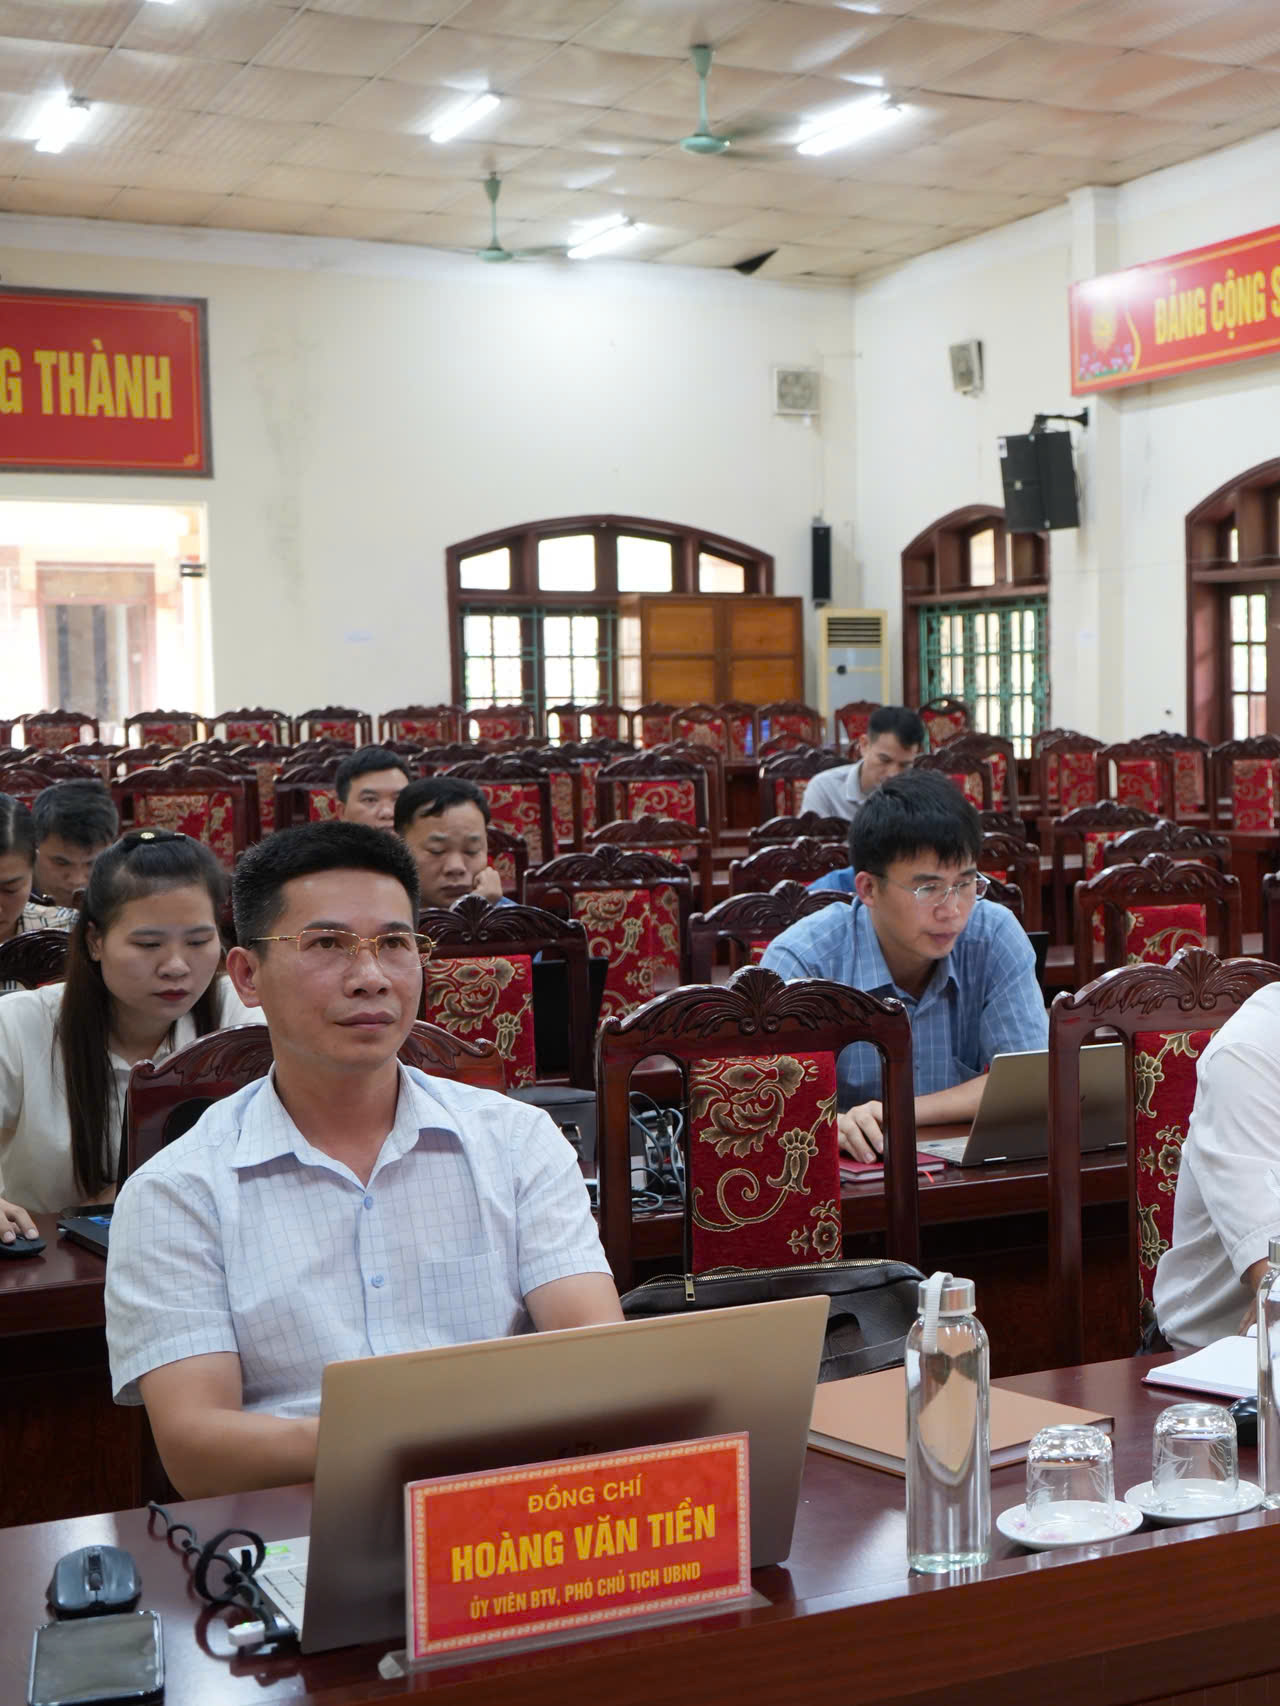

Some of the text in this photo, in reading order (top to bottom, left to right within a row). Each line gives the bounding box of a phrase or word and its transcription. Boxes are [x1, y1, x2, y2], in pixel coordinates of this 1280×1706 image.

[1211, 269, 1266, 339] CỘNG
[34, 338, 173, 420] THÀNH
[528, 1473, 642, 1513] ĐỒNG CHÍ
[451, 1496, 716, 1583] HOÀNG VĂN TIỀN
[469, 1595, 490, 1619] ỦY
[493, 1591, 527, 1615] VIÊN
[565, 1577, 593, 1602] PHÓ
[597, 1569, 625, 1597] CHỦ
[629, 1568, 660, 1594] TỊCH
[663, 1562, 701, 1584] UBND
